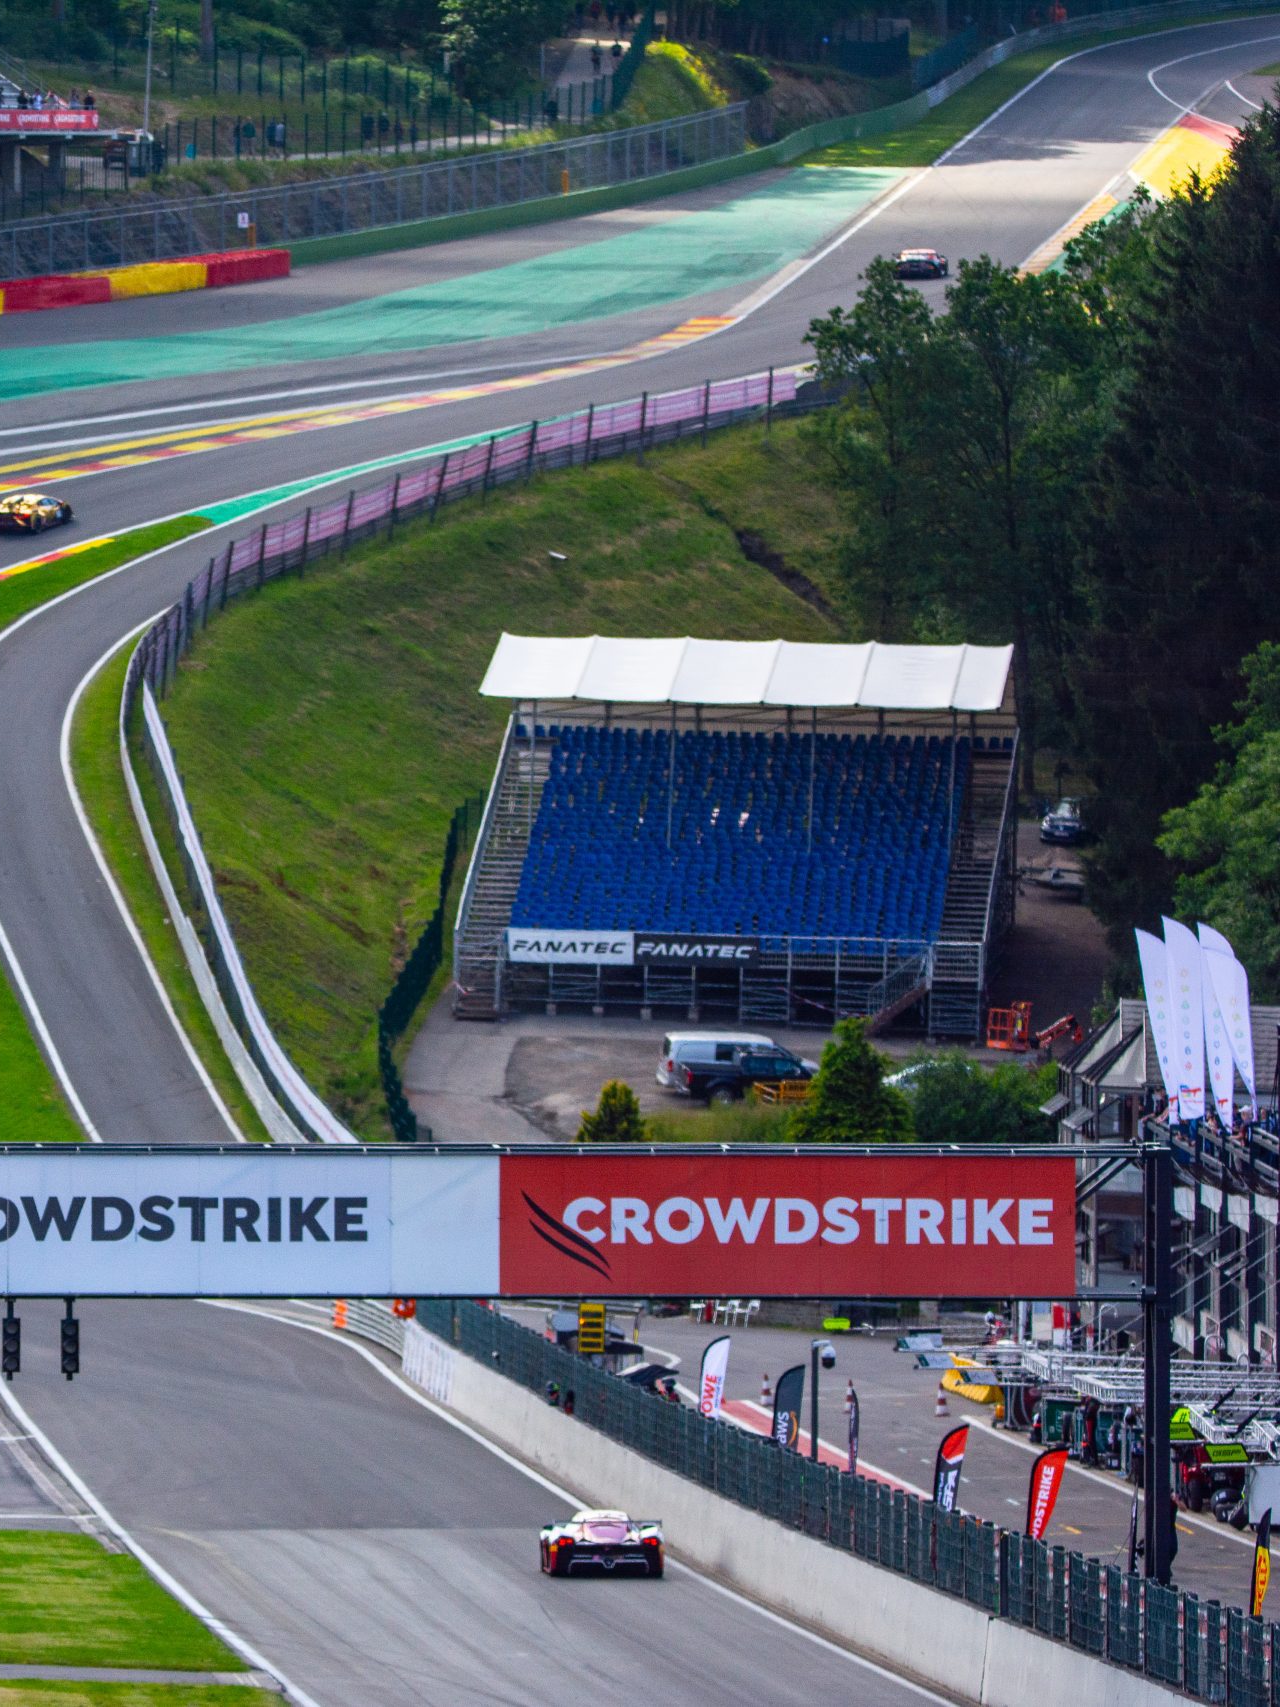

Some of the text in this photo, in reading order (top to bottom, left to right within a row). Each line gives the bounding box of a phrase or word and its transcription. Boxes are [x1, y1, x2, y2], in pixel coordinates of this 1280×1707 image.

[513, 940, 627, 955] FANATEC
[636, 942, 752, 959] FANATEC
[562, 1197, 1054, 1245] CROWDSTRIKE
[701, 1374, 717, 1416] OWE
[776, 1411, 790, 1444] aws
